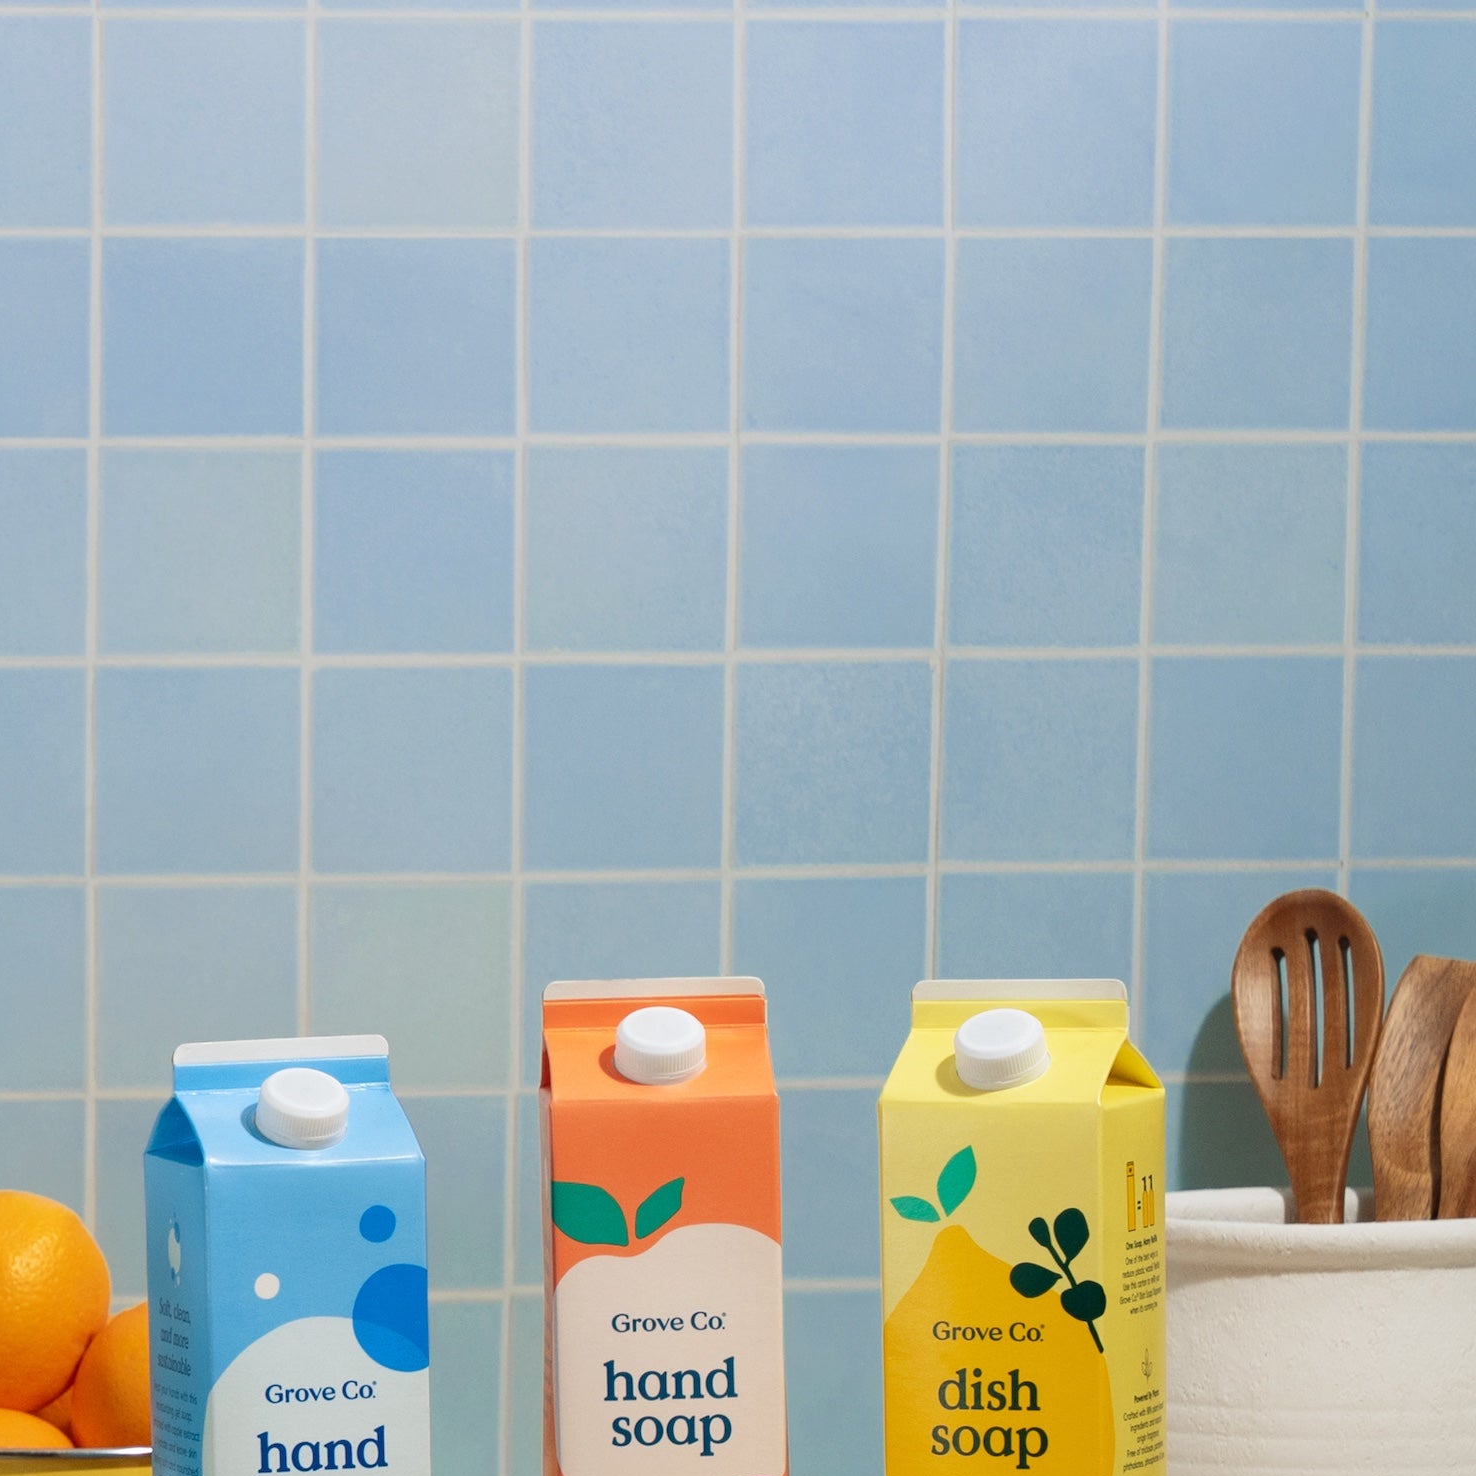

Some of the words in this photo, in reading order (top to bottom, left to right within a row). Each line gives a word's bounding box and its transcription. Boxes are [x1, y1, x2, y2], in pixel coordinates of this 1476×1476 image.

[611, 1313, 684, 1333] Grove
[932, 1320, 1003, 1342] Grove
[265, 1384, 336, 1404] Grove
[603, 1356, 739, 1402] hand
[938, 1367, 1041, 1412] dish
[256, 1424, 389, 1474] hand
[611, 1413, 732, 1457] soap
[931, 1425, 1049, 1470] soap
